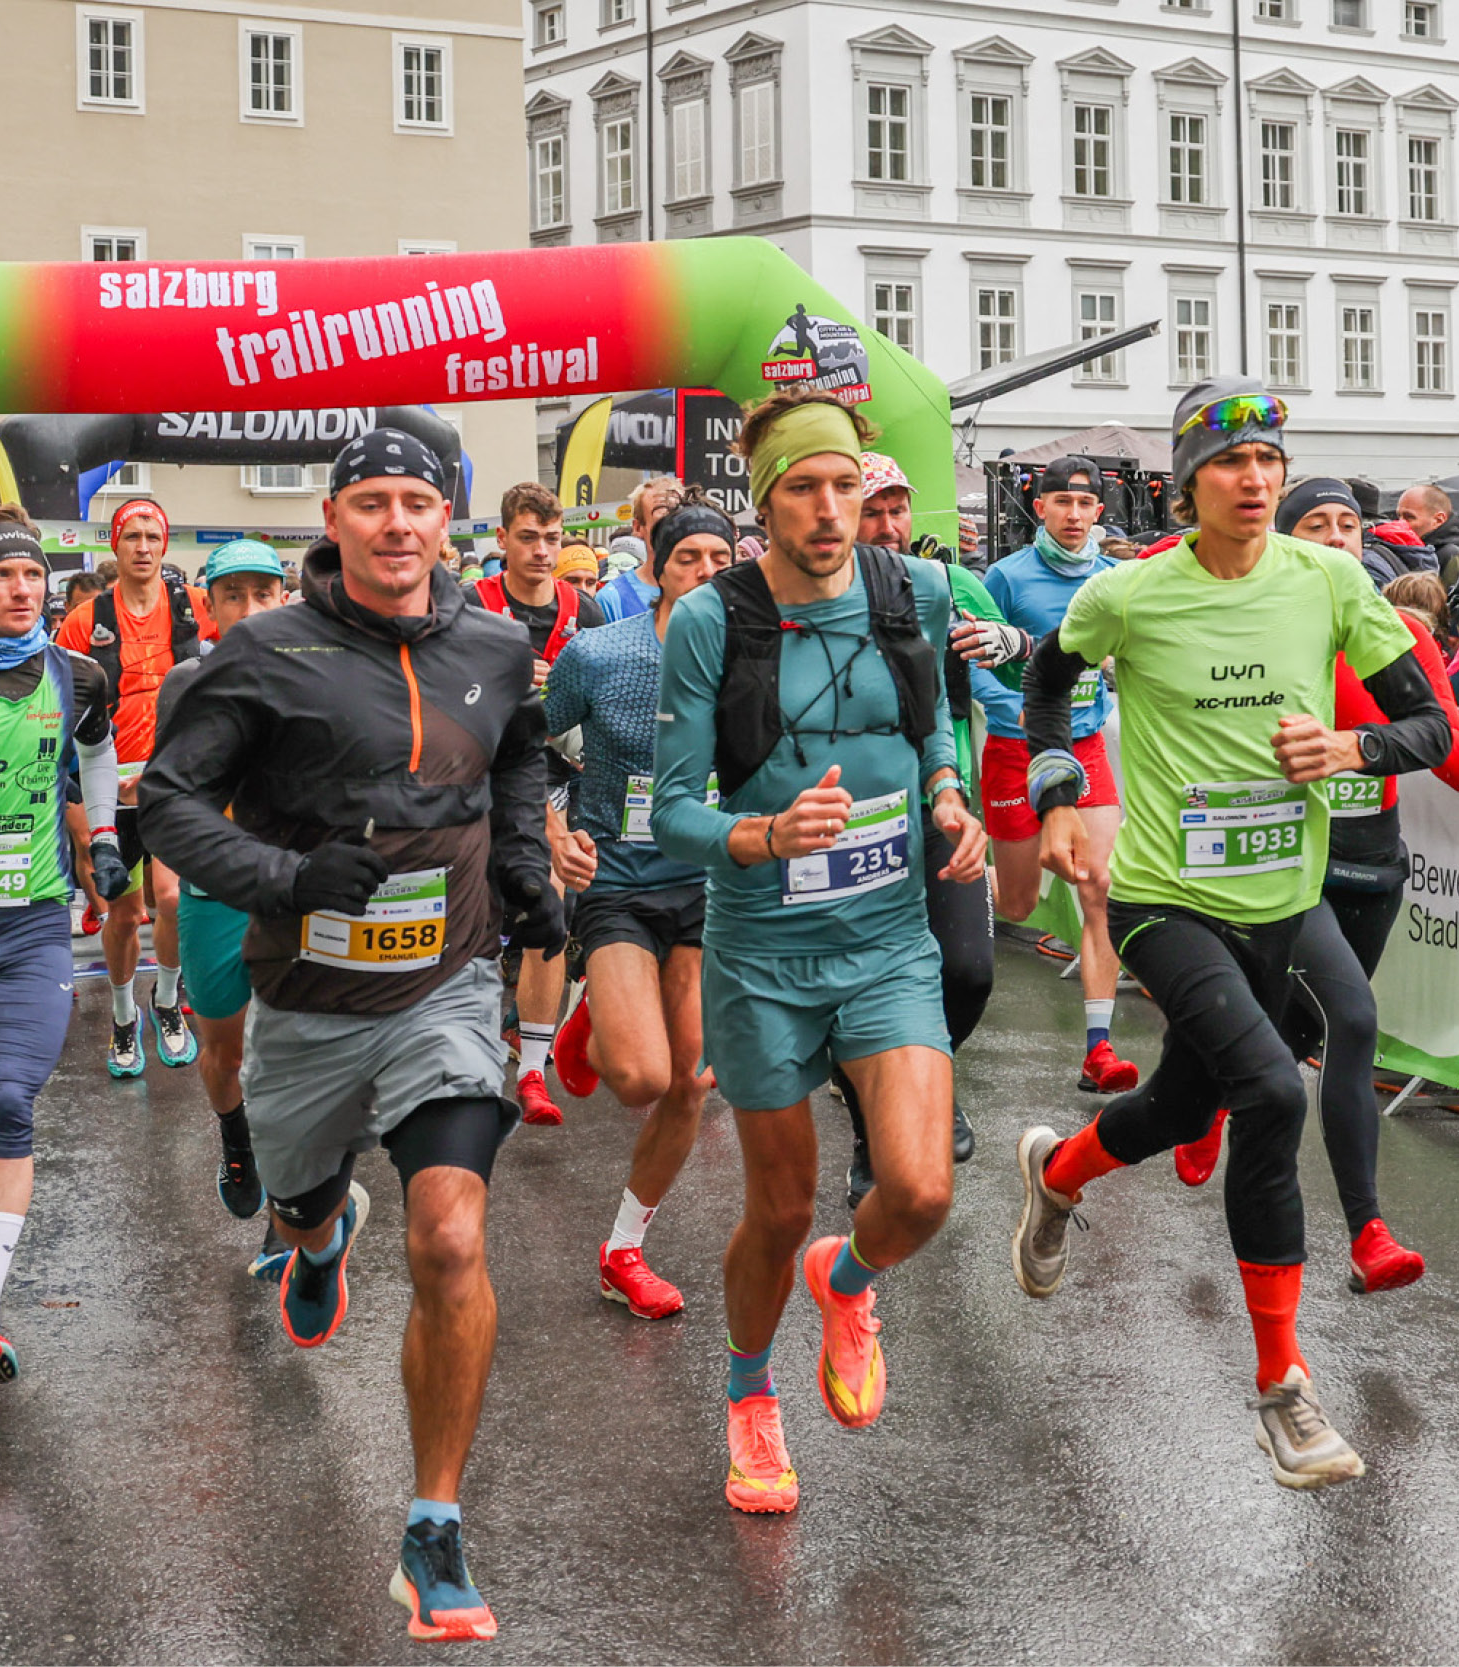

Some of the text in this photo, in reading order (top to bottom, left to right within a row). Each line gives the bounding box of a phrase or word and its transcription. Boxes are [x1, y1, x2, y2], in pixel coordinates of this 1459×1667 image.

[100, 268, 278, 316] salzburg
[216, 279, 506, 387] trailrunning
[445, 337, 599, 396] festival
[764, 362, 813, 379] salzburg
[157, 406, 376, 441] SALOMON
[1194, 691, 1284, 709] xc-run.de
[1326, 780, 1380, 801] 1922
[1237, 826, 1297, 855] 1933
[849, 842, 894, 875] 231
[362, 924, 437, 951] 1658
[378, 952, 418, 961] EMANUEL
